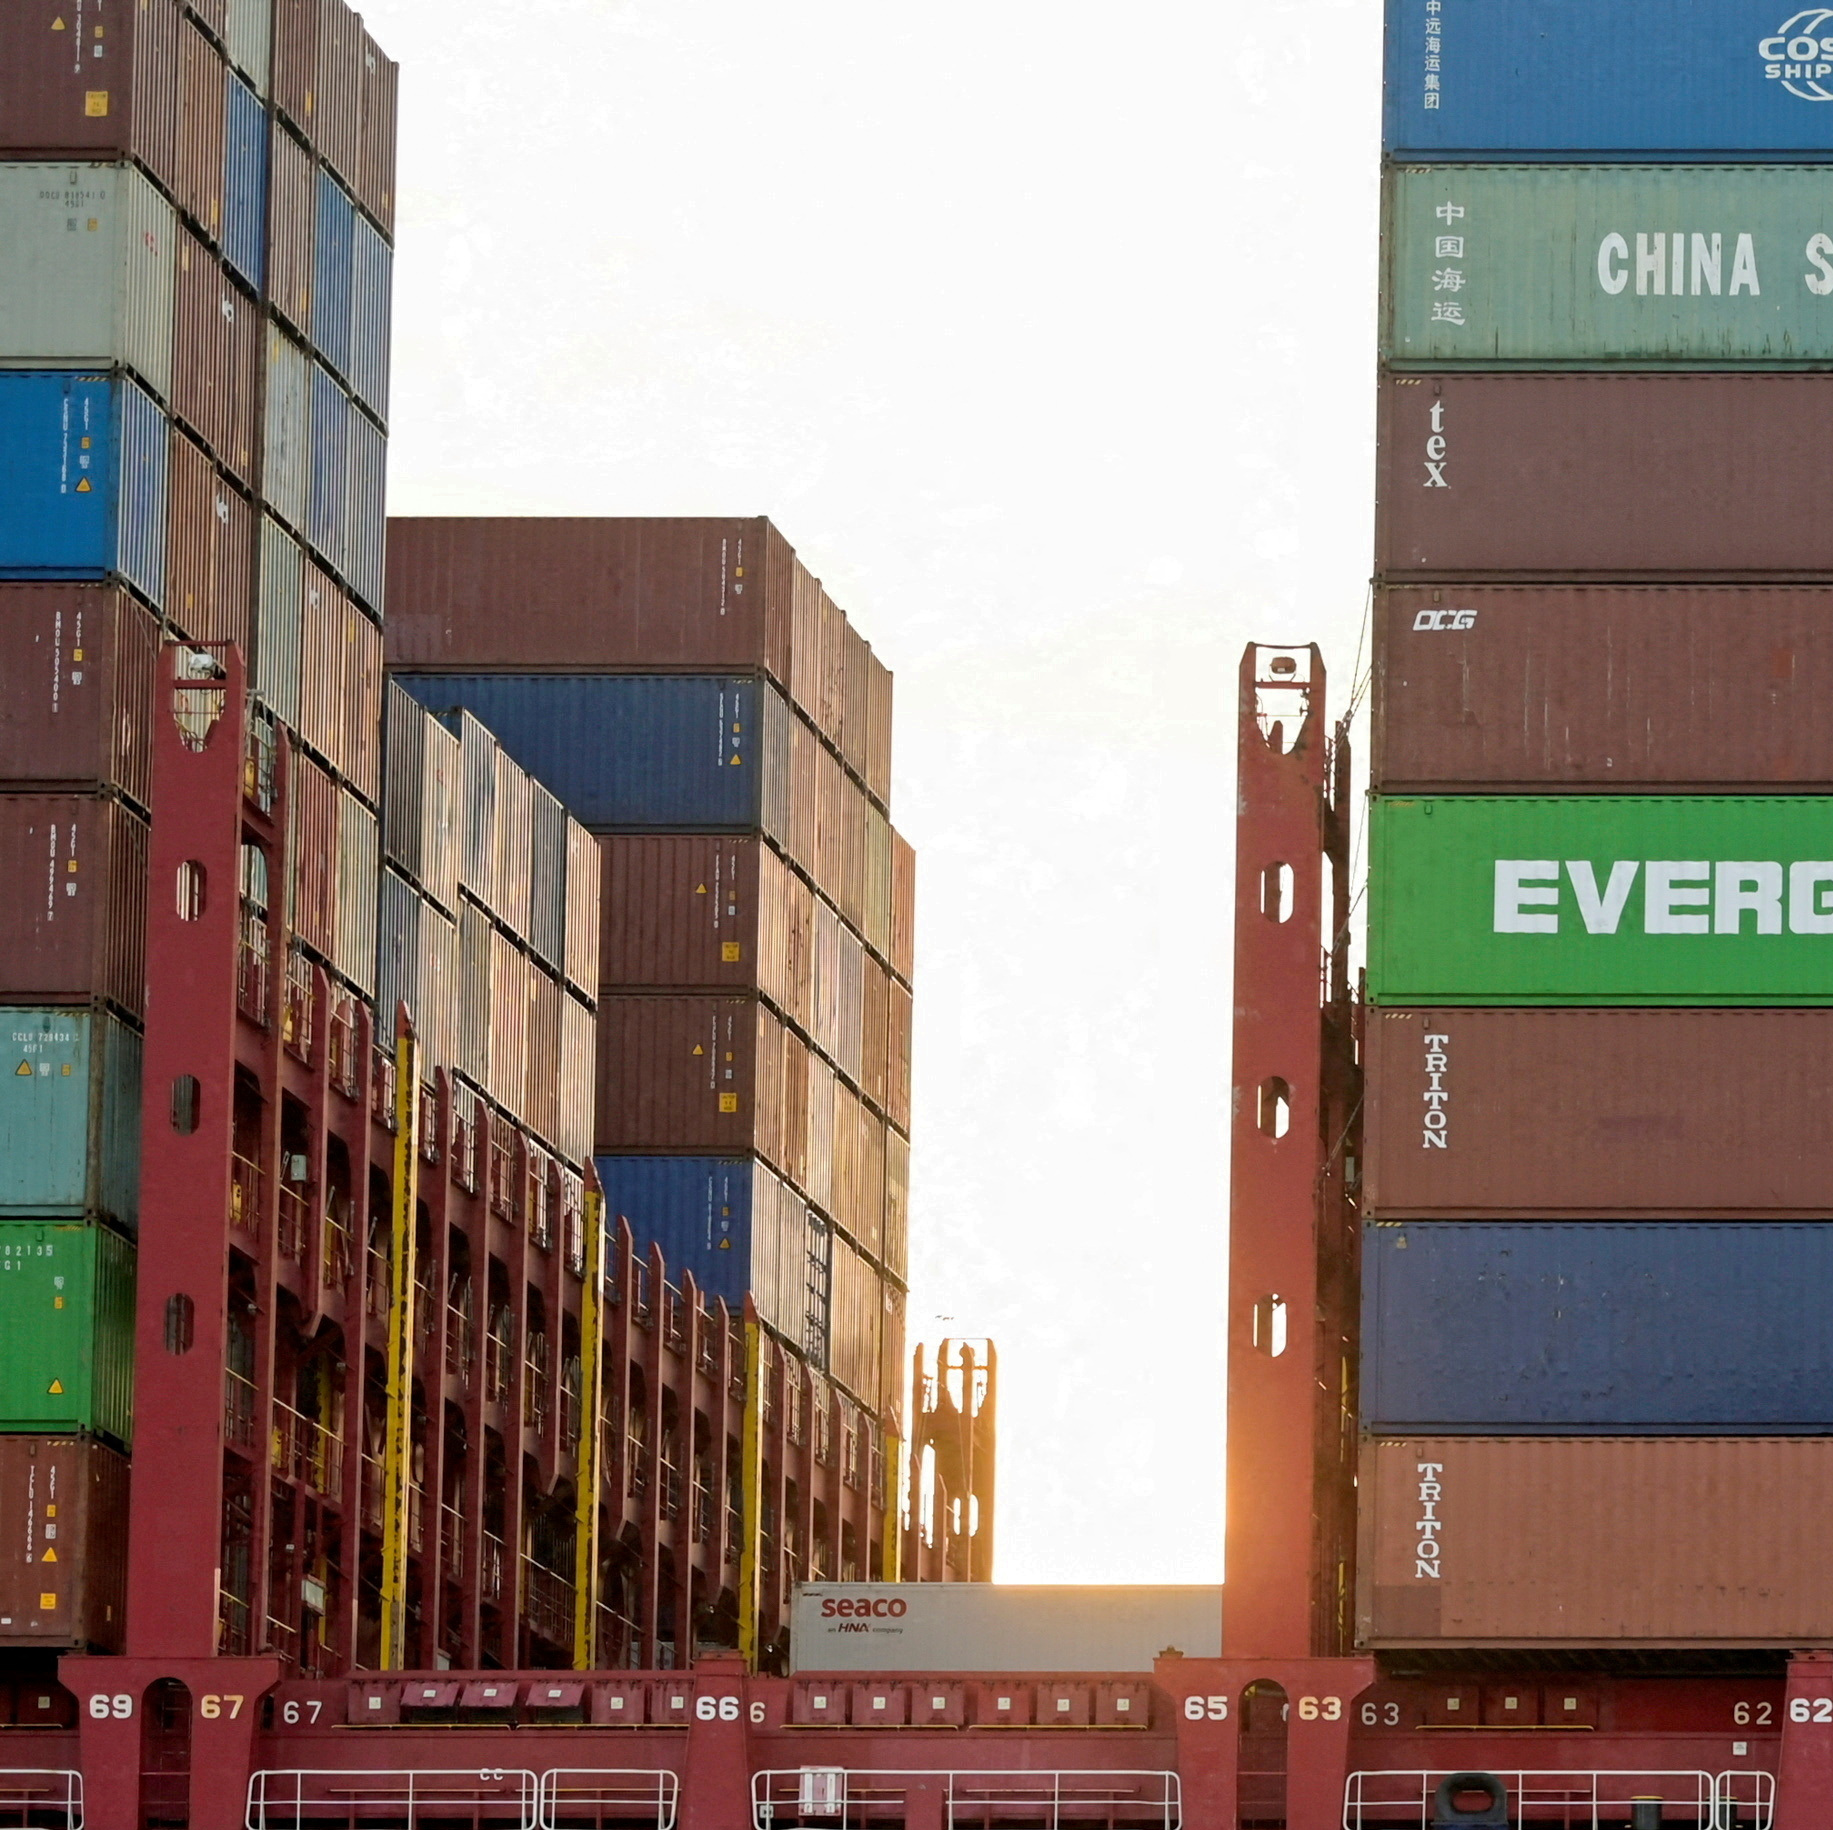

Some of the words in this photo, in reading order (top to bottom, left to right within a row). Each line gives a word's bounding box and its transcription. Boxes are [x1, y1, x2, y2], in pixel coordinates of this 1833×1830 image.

[1431, 201, 1465, 325] 中国海运
[1598, 233, 1760, 295] CHINA
[1424, 401, 1447, 487] tex
[1423, 1035, 1448, 1148] TRITON
[1415, 1463, 1442, 1577] TRITON
[821, 1599, 906, 1617] seaco
[90, 1695, 132, 1718] 69
[201, 1695, 243, 1719] 67
[284, 1701, 321, 1723] 67
[697, 1697, 738, 1720] 66
[1185, 1696, 1227, 1720] 65
[1299, 1697, 1341, 1720] 63
[1362, 1703, 1398, 1725] 63
[1734, 1702, 1771, 1724] 62
[1790, 1698, 1832, 1722] 62
